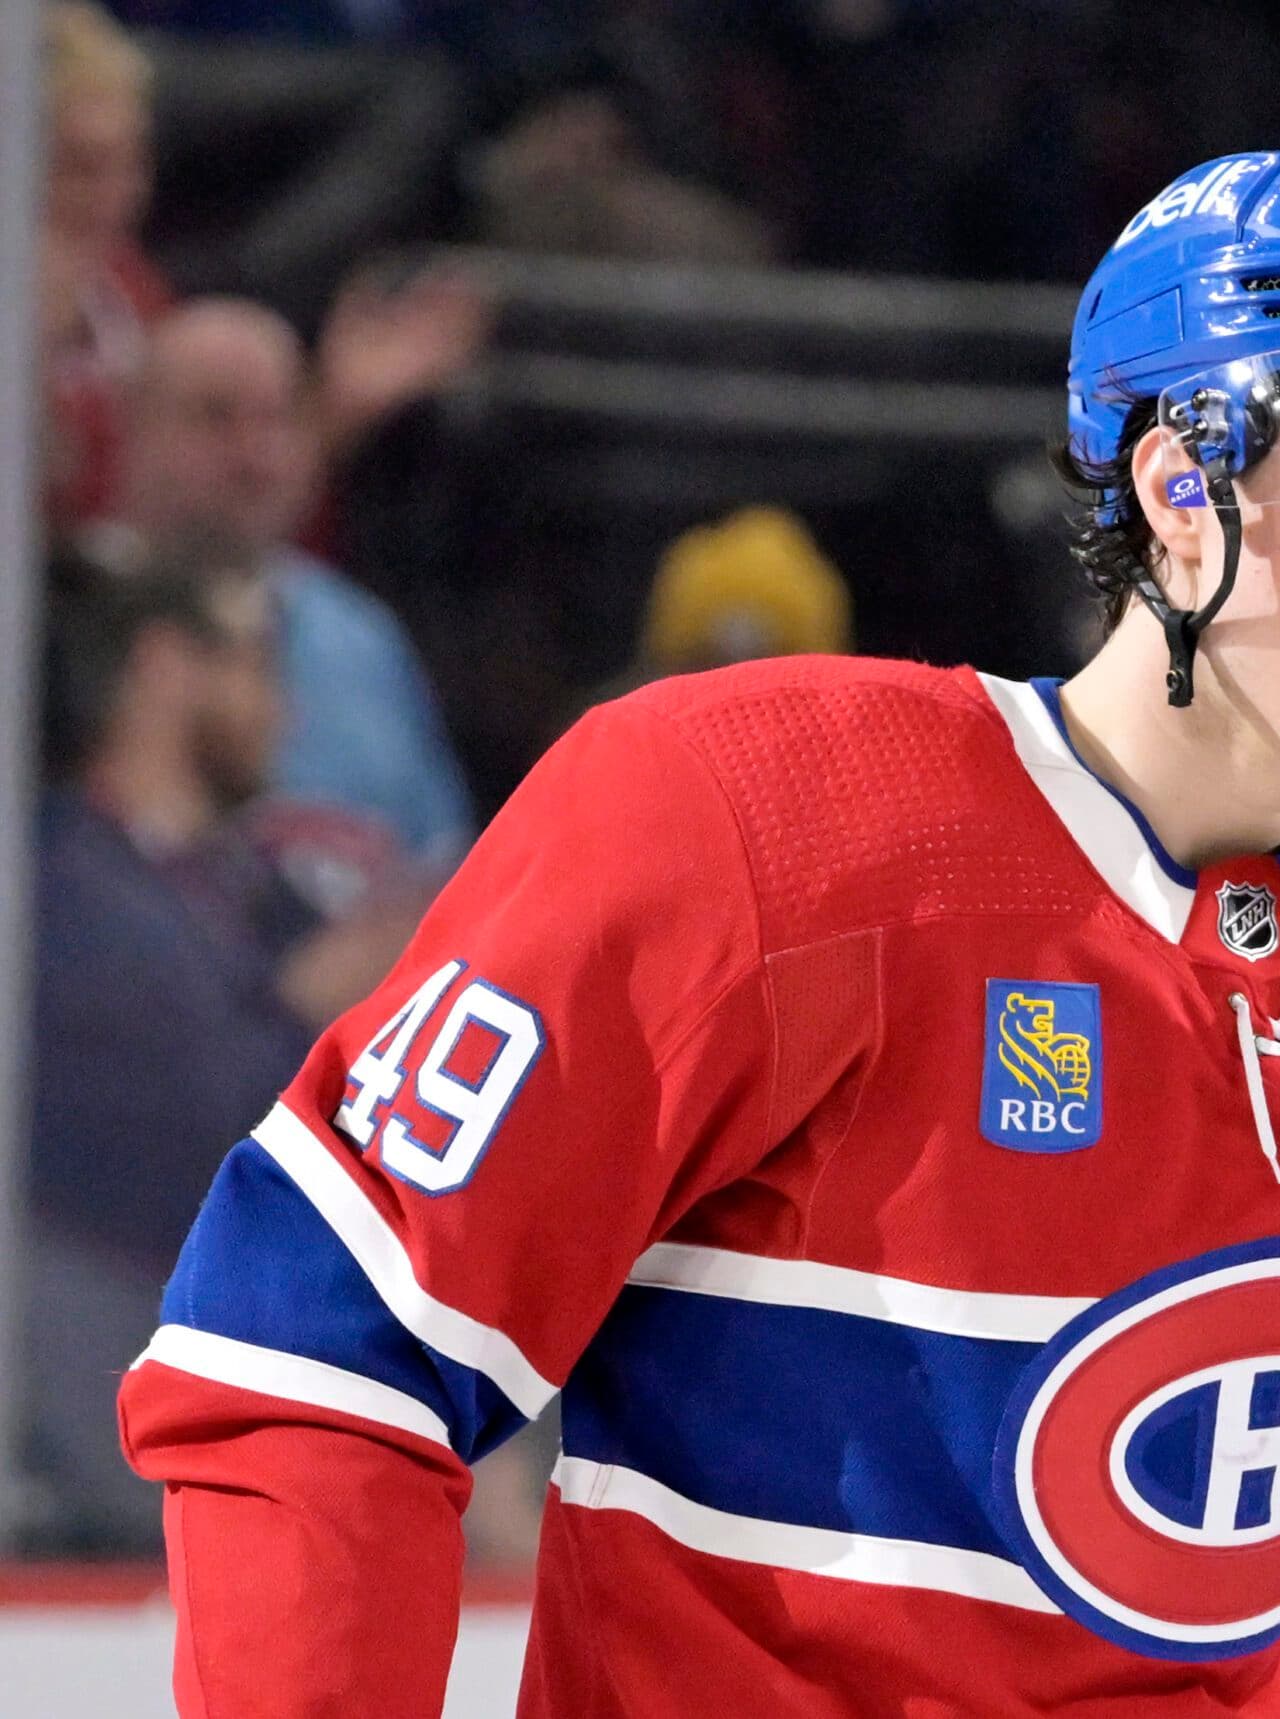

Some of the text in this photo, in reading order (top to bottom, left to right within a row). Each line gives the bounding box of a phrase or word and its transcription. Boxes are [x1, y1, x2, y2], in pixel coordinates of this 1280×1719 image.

[1230, 900, 1265, 942] LNH
[333, 957, 548, 1198] 49
[1000, 1098, 1087, 1134] RBC
